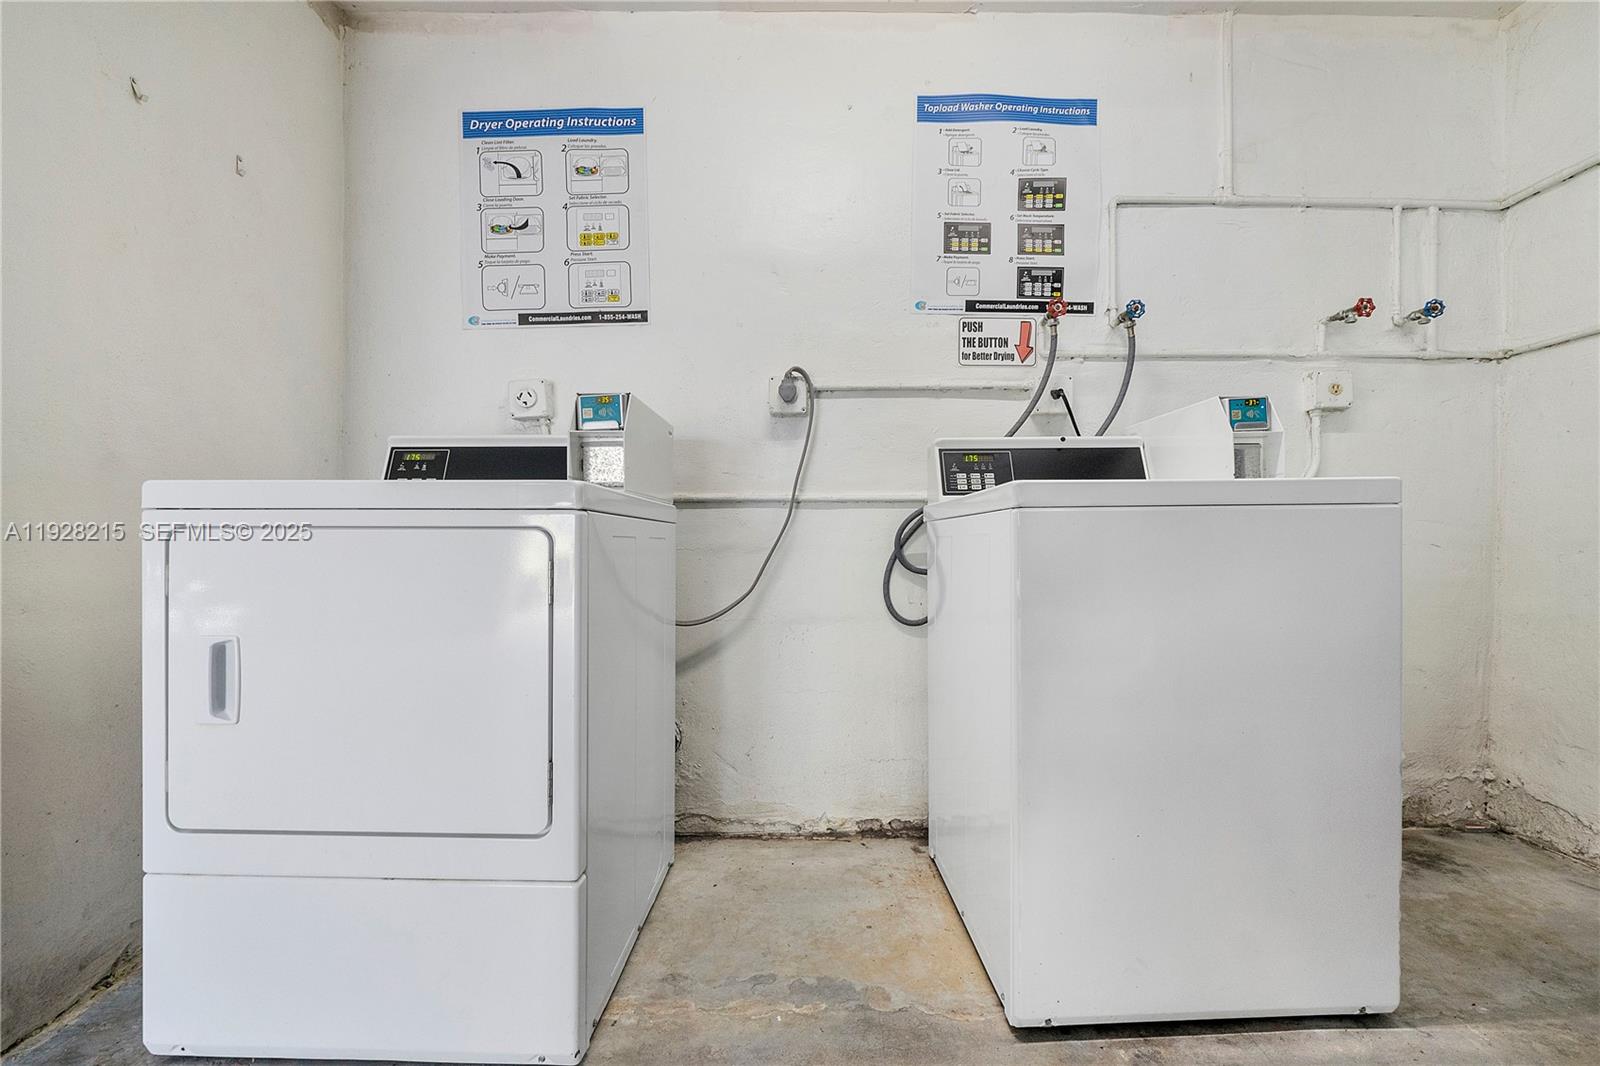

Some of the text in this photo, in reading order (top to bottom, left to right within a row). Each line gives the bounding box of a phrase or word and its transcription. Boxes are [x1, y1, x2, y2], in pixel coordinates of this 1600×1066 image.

[923, 102, 1091, 116] Topload Washer Operating Instructions
[469, 115, 637, 132] Dryer Operating Instructions
[476, 146, 480, 154] 1
[561, 144, 567, 152] 2
[476, 203, 482, 211] 3
[478, 260, 483, 268] 5
[563, 258, 570, 266] 6
[975, 302, 1039, 311] CommercialLaundries.com
[528, 314, 592, 323] CommercialLaundries.com
[961, 321, 984, 333] PUSH
[961, 337, 1009, 348] THE BUTTON
[961, 351, 1015, 362] for Better Drying
